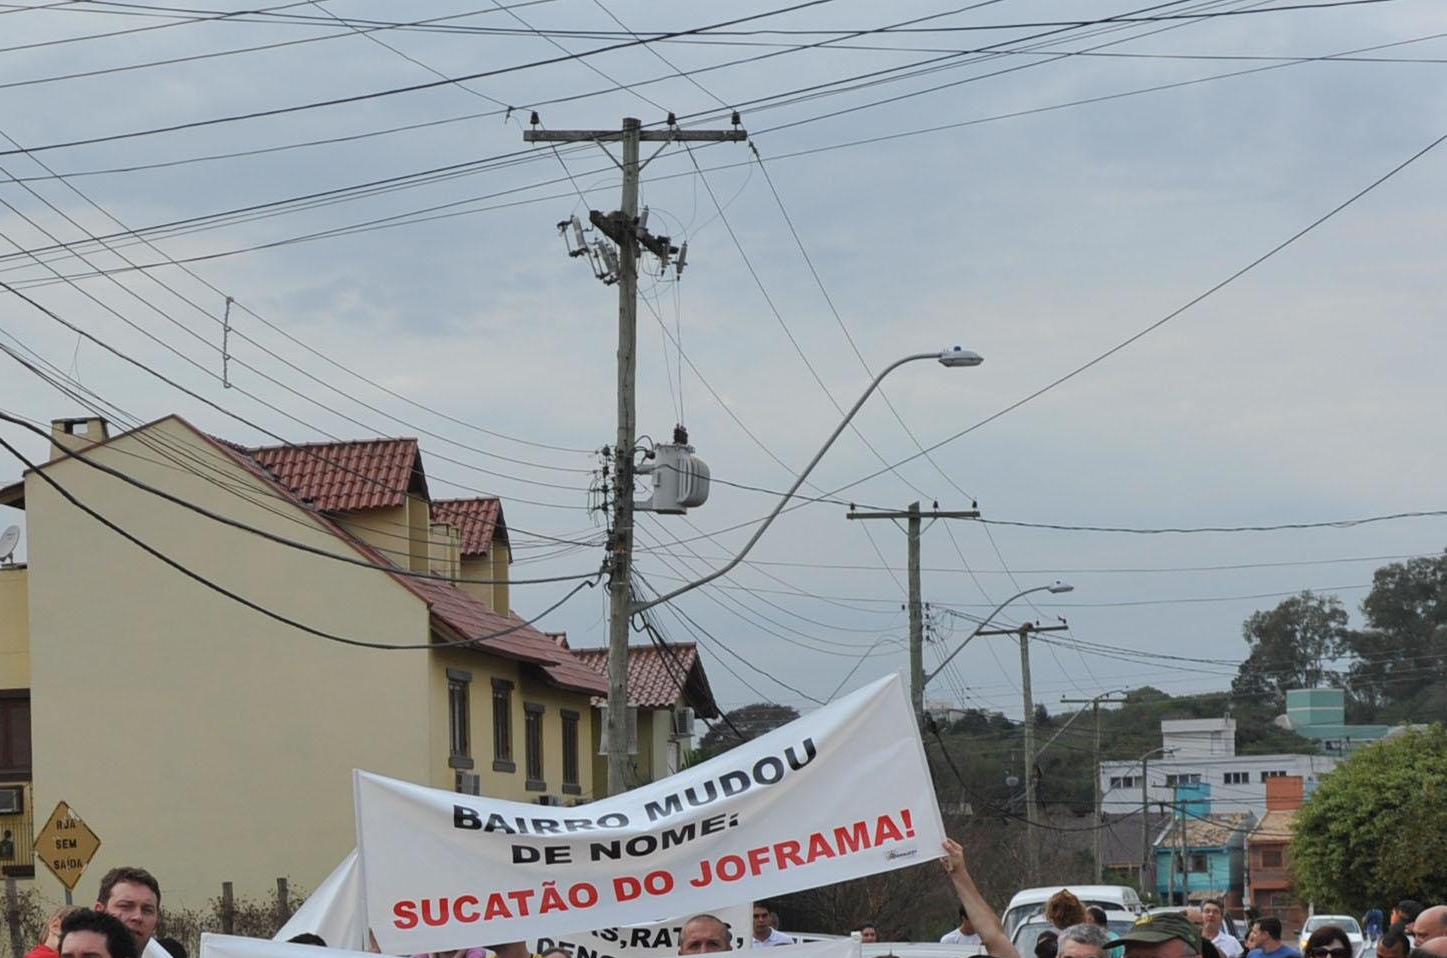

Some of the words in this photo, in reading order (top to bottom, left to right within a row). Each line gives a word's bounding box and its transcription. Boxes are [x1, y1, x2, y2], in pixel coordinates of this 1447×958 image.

[453, 804, 630, 836] BAIRRO
[644, 737, 818, 822] MUDOU
[55, 839, 77, 849] SEM
[392, 881, 600, 930] SUCATÃO
[612, 869, 675, 904] DO
[689, 809, 917, 888] JOFRAMA!
[511, 843, 572, 866] DE
